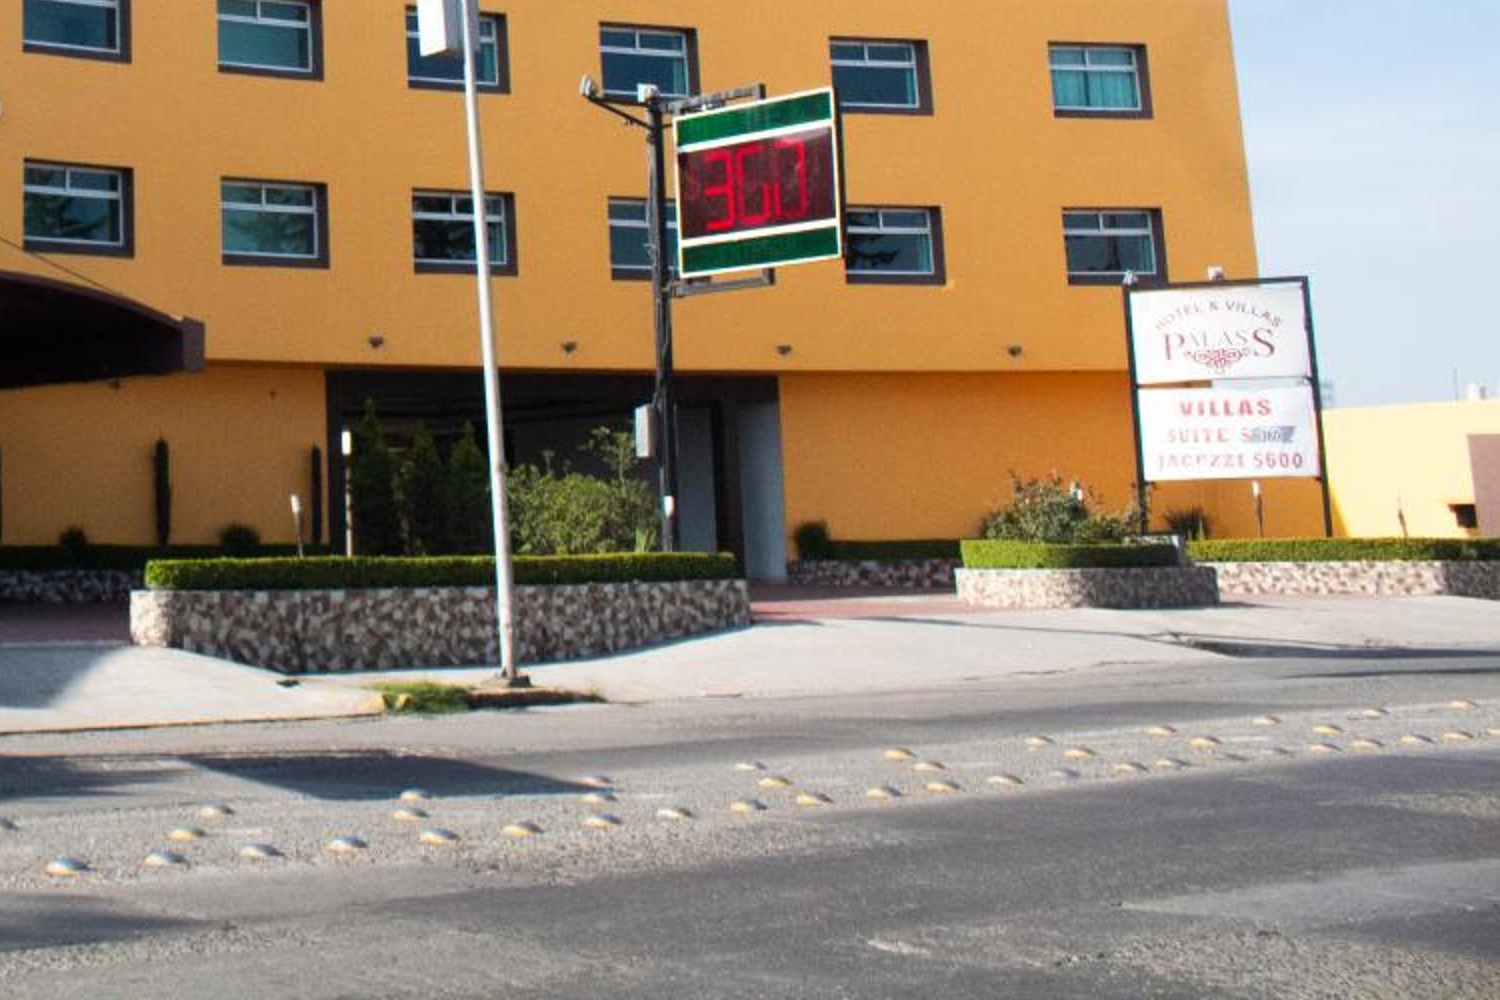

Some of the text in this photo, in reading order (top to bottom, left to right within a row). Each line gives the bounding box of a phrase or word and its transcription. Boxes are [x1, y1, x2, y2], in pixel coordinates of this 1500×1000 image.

[1156, 303, 1204, 331] HOTEL
[1224, 301, 1283, 327] VILLAS
[1164, 328, 1275, 360] PALASS
[1180, 400, 1272, 416] VILLAS
[1167, 428, 1229, 443] SUITE
